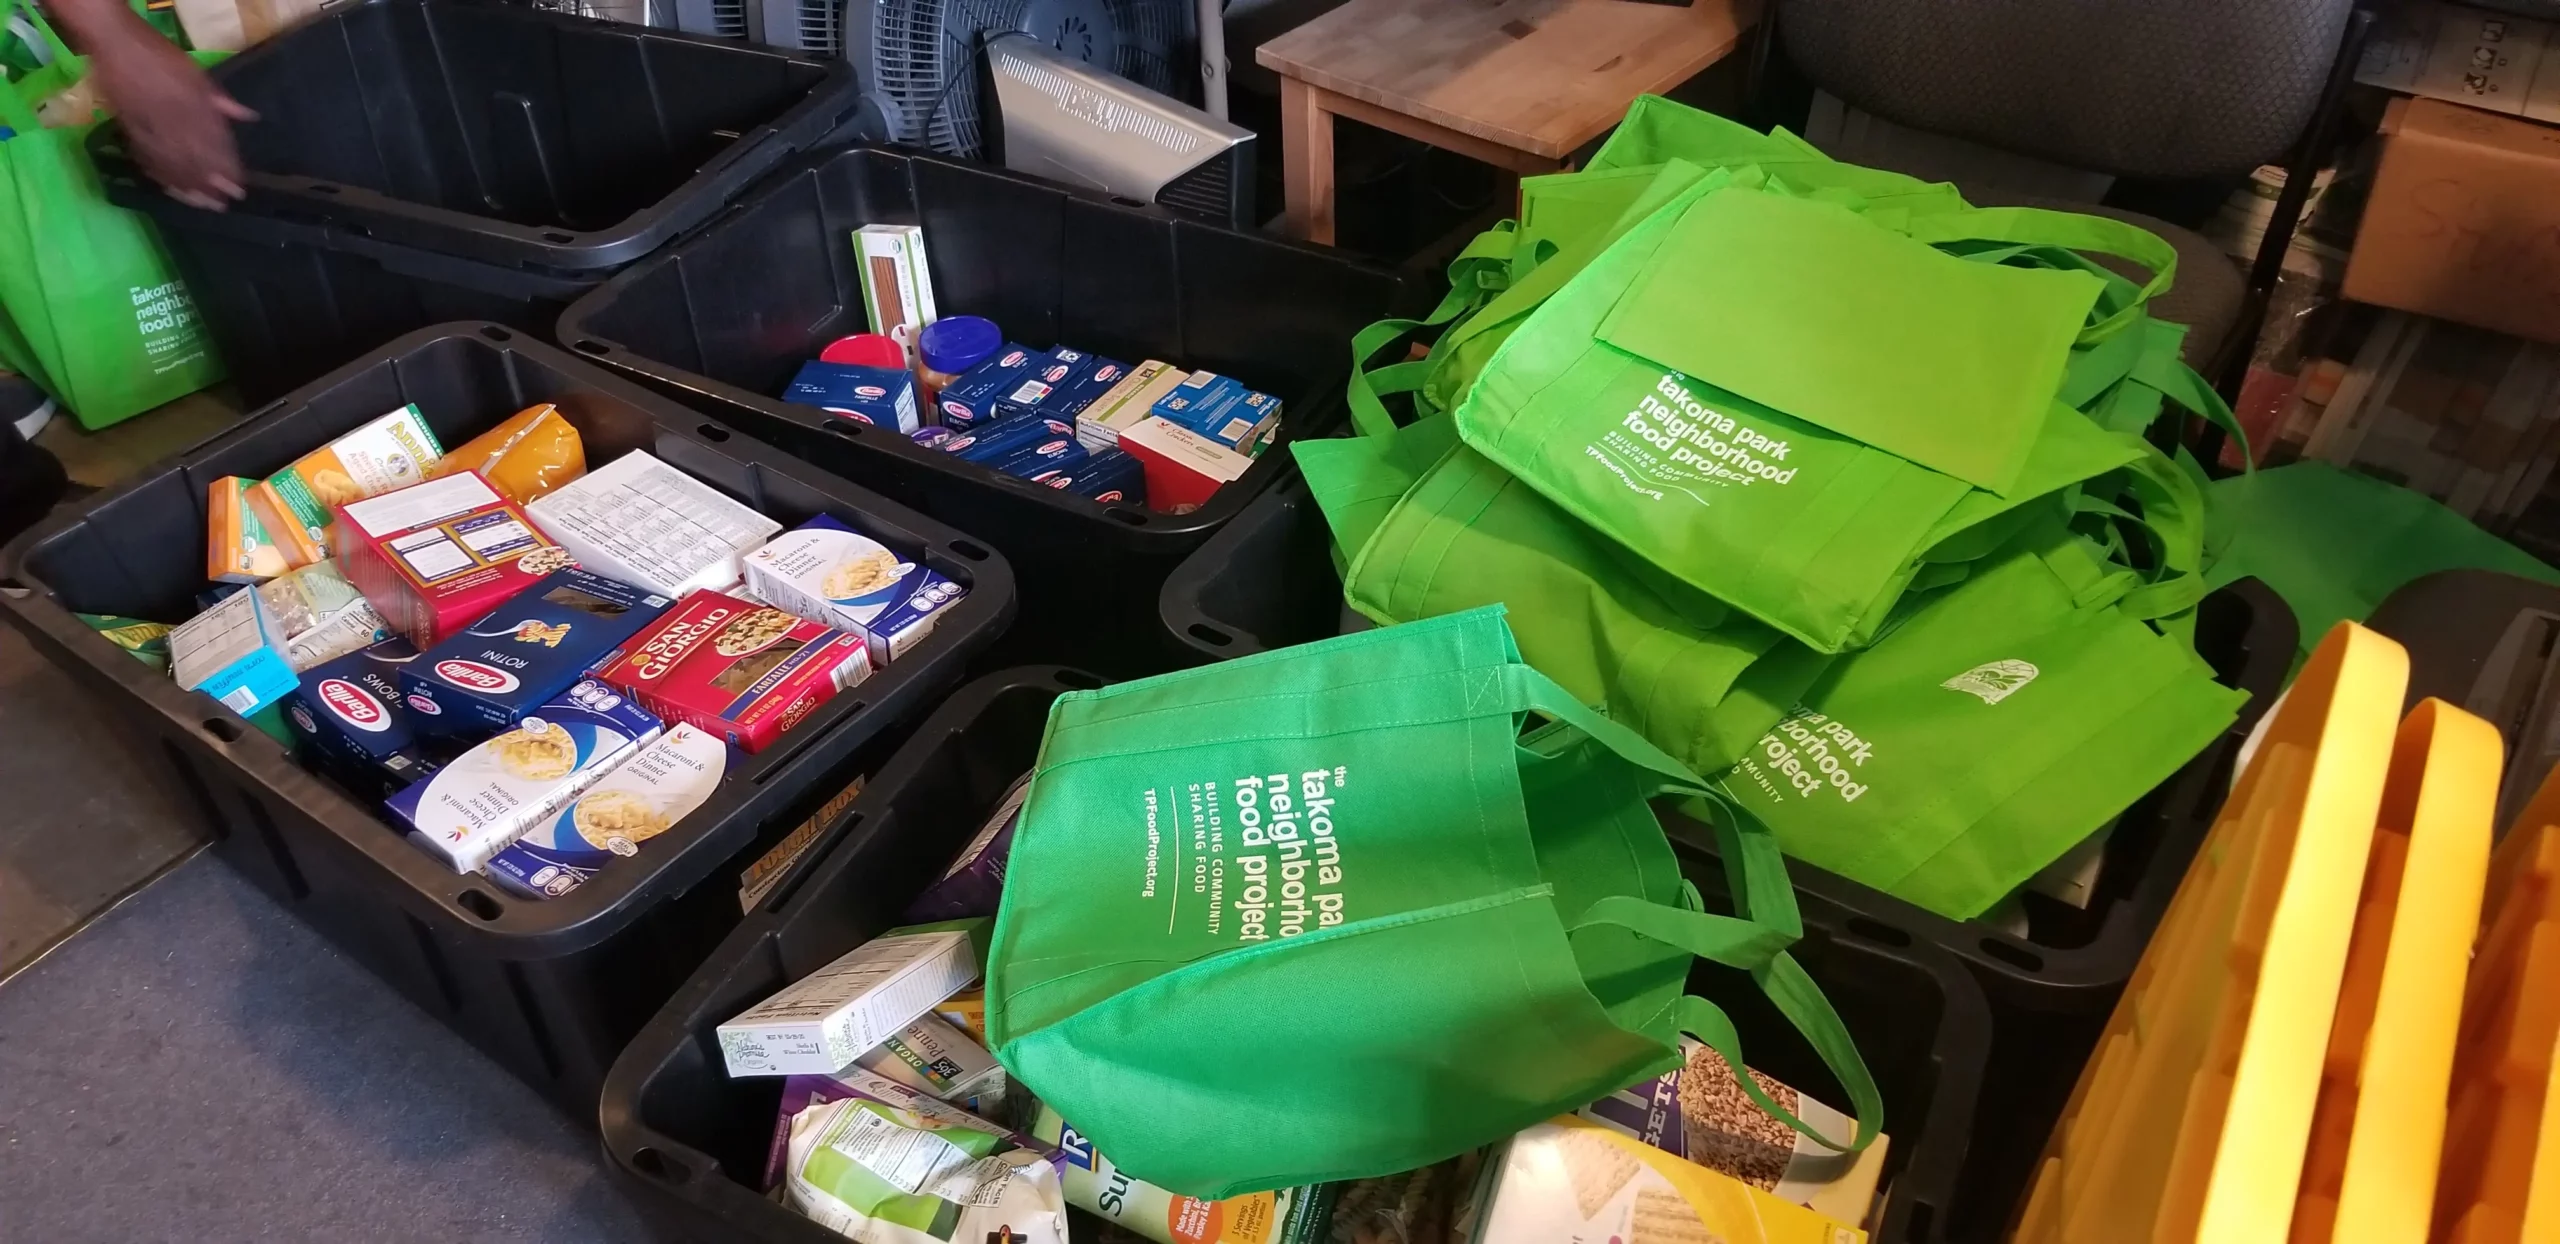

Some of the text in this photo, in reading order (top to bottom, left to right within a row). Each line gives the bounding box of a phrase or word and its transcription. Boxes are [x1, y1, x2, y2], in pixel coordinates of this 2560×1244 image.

[140, 313, 174, 334] food
[950, 404, 970, 418] Barilla
[1656, 374, 1792, 461] takoma park
[1103, 428, 1118, 438] Facts
[1166, 431, 1194, 446] Crackers
[1638, 394, 1798, 486] neighborhood
[386, 420, 436, 480] Annie
[1047, 448, 1068, 459] ELBOWS
[1602, 435, 1680, 481] SHARING FOOD
[1608, 430, 1729, 488] BUILDING COMMUNITY
[1622, 410, 1756, 486] food project
[348, 452, 367, 474] Aged
[1585, 445, 1664, 501] TPFoodProject.org
[770, 542, 812, 568] Macaroni
[778, 552, 808, 572] Cheese
[784, 556, 817, 576] Dinner
[794, 559, 828, 580] ORIGINAL
[360, 629, 370, 638] 60
[639, 608, 730, 680] GIORGIO
[646, 622, 693, 654] SAN
[244, 656, 266, 670] corn
[480, 650, 530, 669] ROTINI
[212, 668, 244, 691] muffin
[442, 663, 502, 687] Barilla
[752, 664, 792, 695] FARFALLE
[325, 683, 378, 720] Barilla
[781, 696, 816, 732] GIORGIO
[788, 698, 804, 715] SAN
[656, 744, 705, 772] Macaroni &
[1816, 721, 1873, 767] park
[636, 758, 668, 777] Dinner
[646, 750, 676, 769] Cheese
[1732, 766, 1740, 774] D
[1758, 732, 1822, 798] roject
[1778, 719, 1869, 802] borhood
[627, 766, 659, 786] ORIGINAL
[1334, 766, 1347, 788] the
[479, 790, 510, 816] Dinner
[490, 782, 520, 806] ORIGINAL
[450, 795, 488, 830] Macaroni
[469, 798, 497, 822] Cheese
[746, 782, 863, 880] TOUGH BOX
[1142, 788, 1160, 898] TPFoodProject.org
[1188, 784, 1206, 894] SHARING FOOD
[1204, 781, 1224, 936] BUILDING COMMUNITY
[1234, 775, 1274, 941] food project
[1267, 773, 1312, 937] neighborho
[1302, 768, 1344, 930] takoma pa
[749, 862, 792, 898] Construction
[886, 1034, 923, 1068] ORGAN
[907, 1025, 945, 1058] Penne
[934, 1062, 958, 1078] 365
[1062, 1128, 1088, 1160] R
[992, 1184, 1006, 1204] Facts
[1176, 1199, 1192, 1233] Made with
[1184, 1210, 1200, 1236] Zucchini,
[1193, 1216, 1208, 1240] Parsley
[1234, 1204, 1248, 1232] Servings
